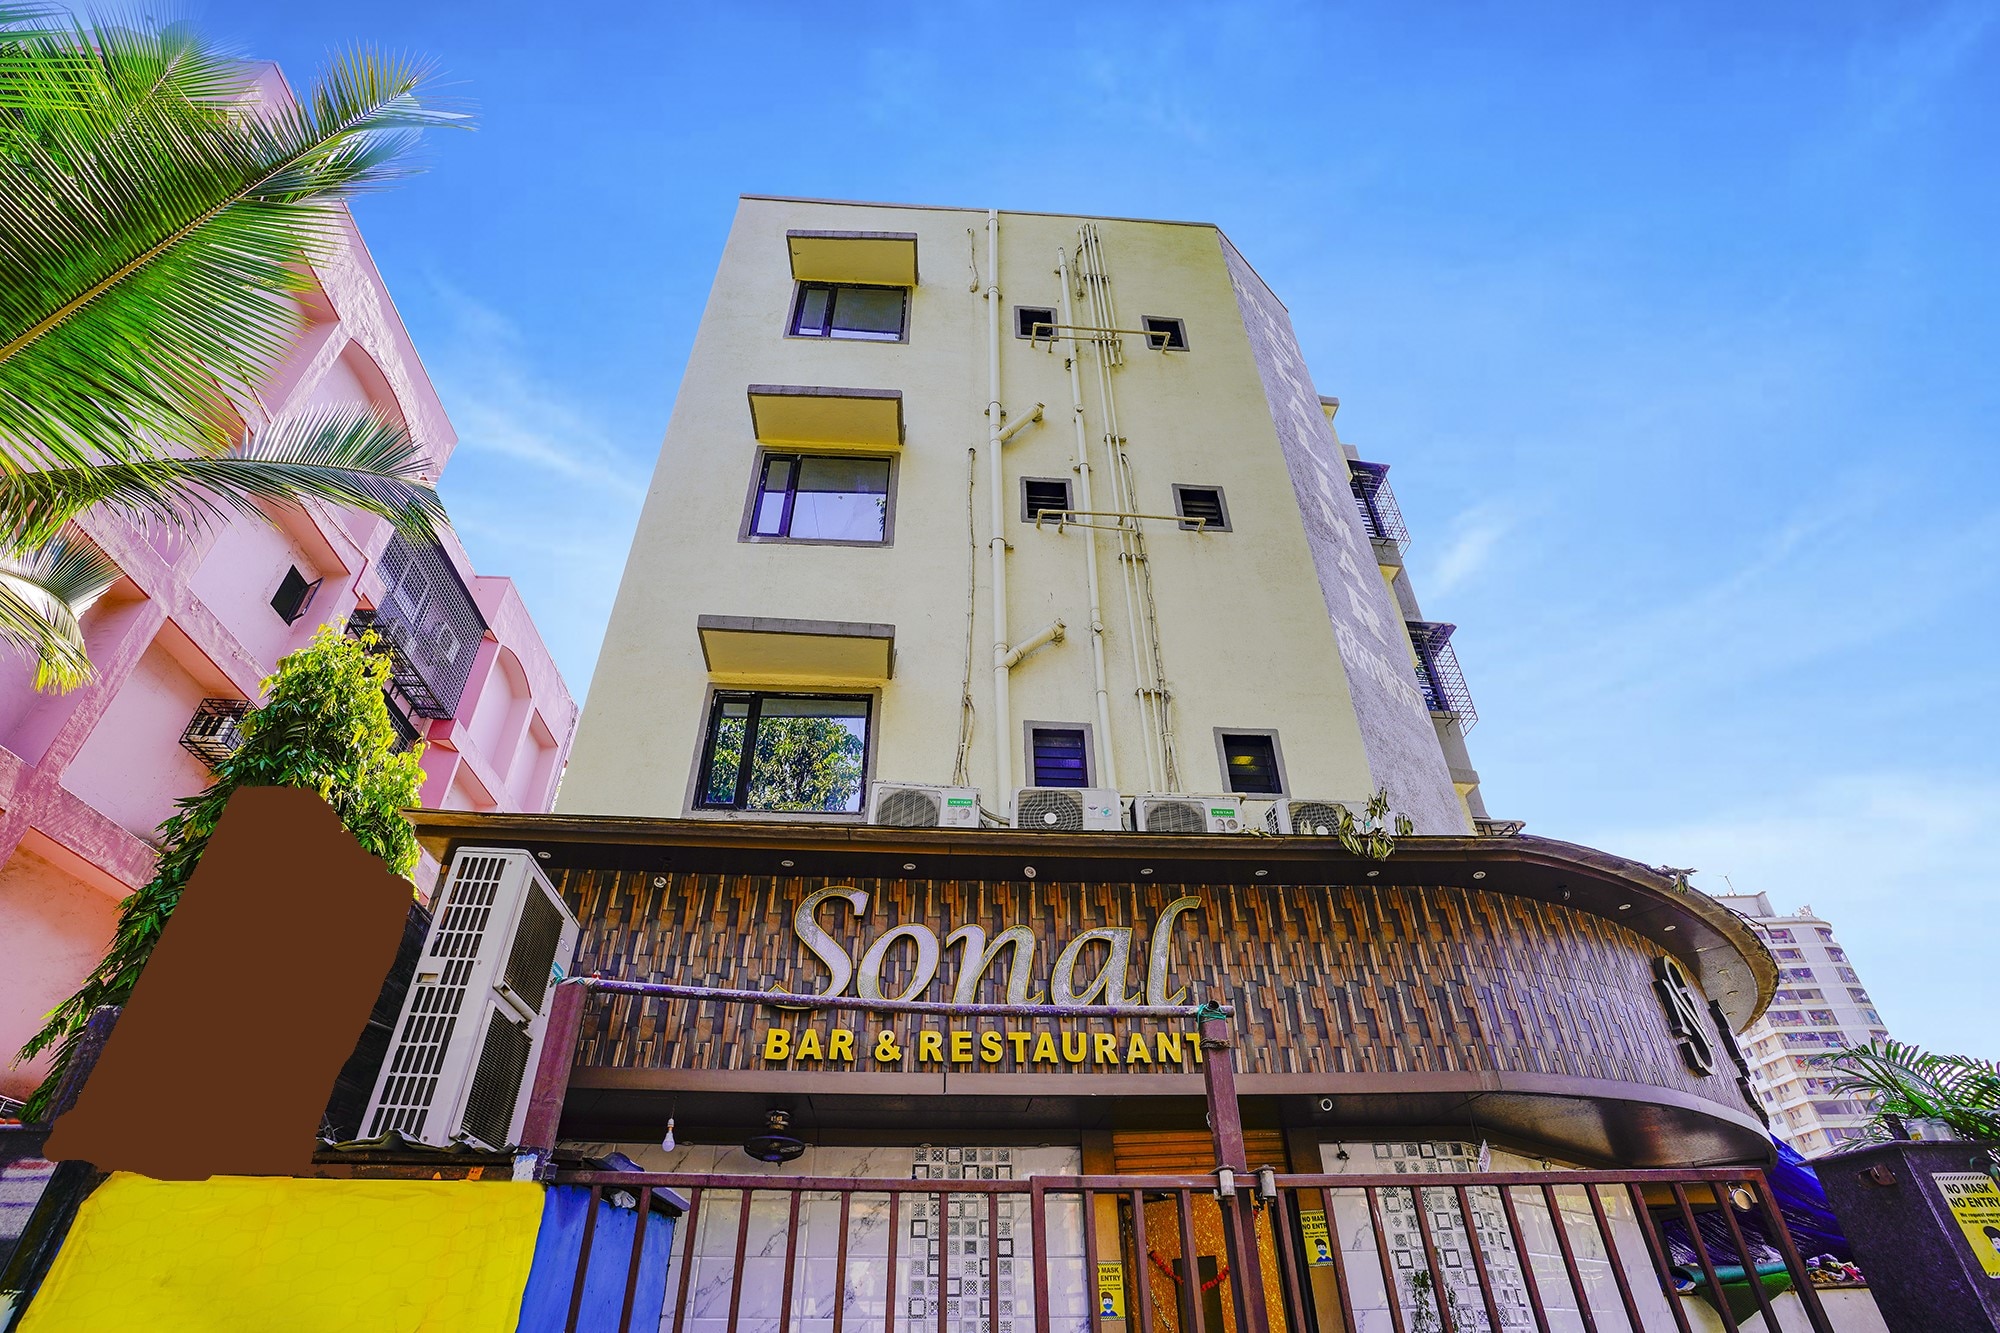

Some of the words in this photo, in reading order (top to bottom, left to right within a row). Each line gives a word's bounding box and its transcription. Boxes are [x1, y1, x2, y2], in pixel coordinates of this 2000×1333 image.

[1229, 271, 1306, 366] HOTEL
[1264, 327, 1388, 646] SHALIMAR
[768, 886, 1202, 1010] Sonal
[764, 1028, 854, 1062] BAR
[874, 1030, 902, 1062] &
[919, 1031, 1203, 1065] RESTAURANT
[1944, 1184, 1960, 1194] NO
[1961, 1183, 1993, 1194] MASK
[1949, 1197, 1966, 1208] NO
[1966, 1196, 2000, 1208] ENTRY
